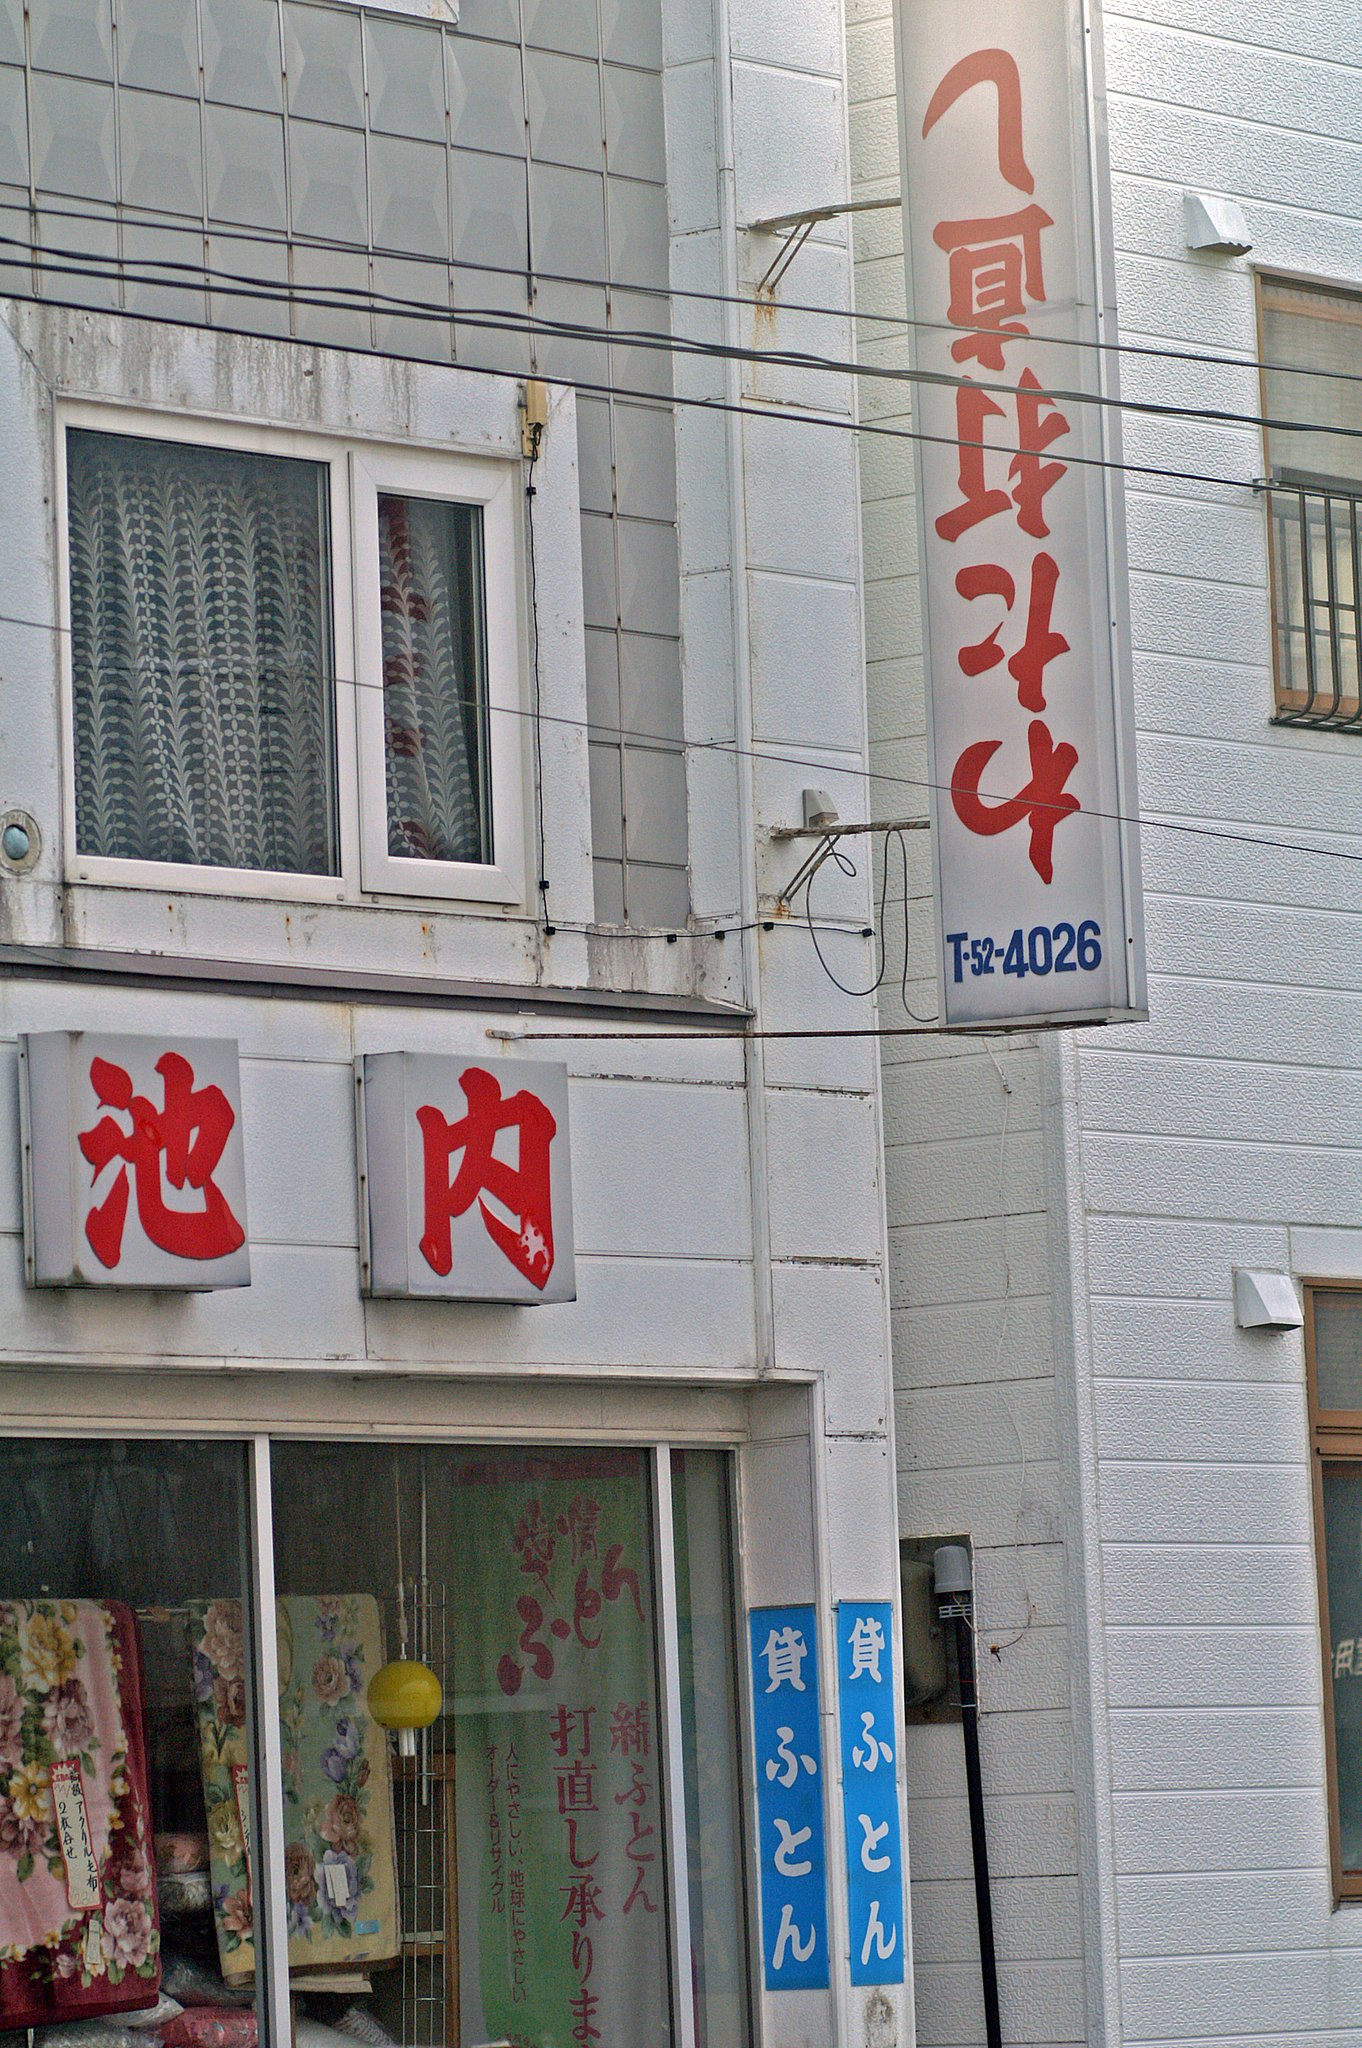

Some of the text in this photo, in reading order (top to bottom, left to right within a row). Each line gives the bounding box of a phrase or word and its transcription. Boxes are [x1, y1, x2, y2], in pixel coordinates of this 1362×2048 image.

[550, 1703, 607, 2048] 打直し承りま
[759, 1627, 818, 1970] 貸ふとん
[848, 1617, 897, 1966] 貸ふとん
